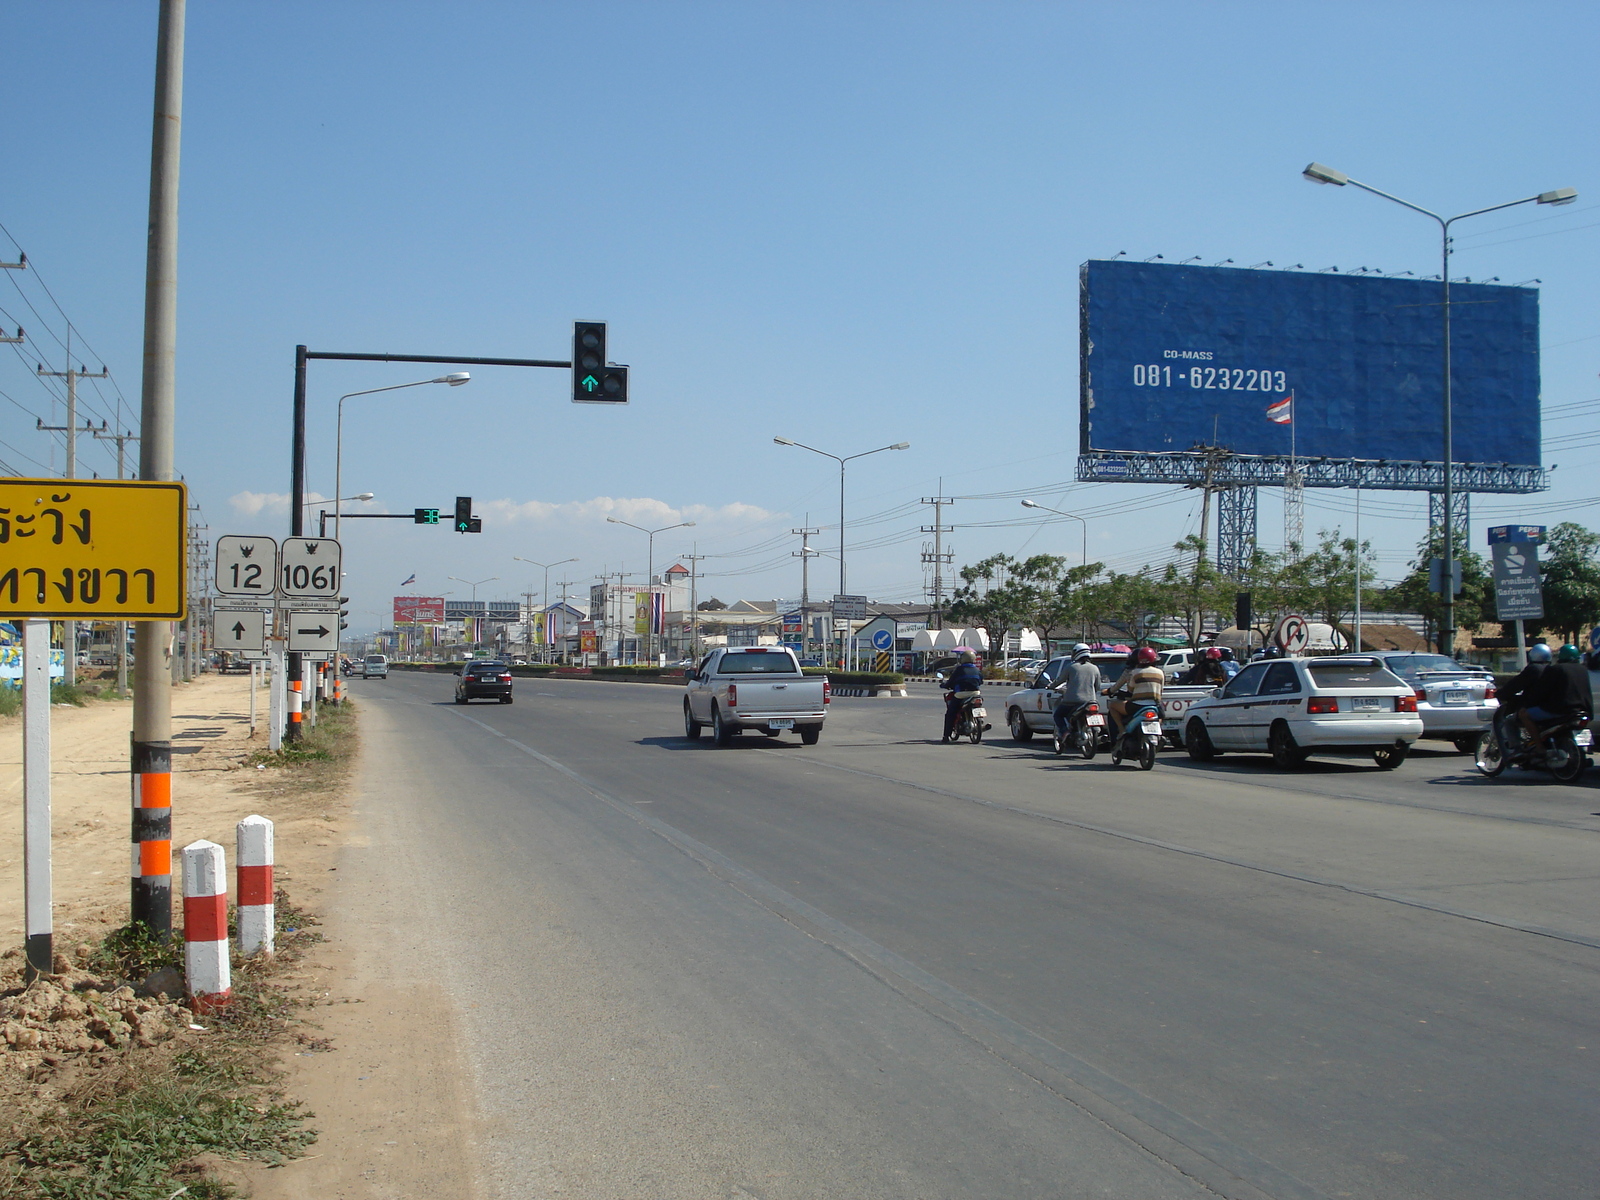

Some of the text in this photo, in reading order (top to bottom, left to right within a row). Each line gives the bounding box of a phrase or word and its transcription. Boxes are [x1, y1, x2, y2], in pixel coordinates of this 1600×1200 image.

[1163, 349, 1213, 361] CO-MASS
[423, 509, 440, 524] 38
[230, 563, 262, 589] 12
[283, 564, 337, 590] 1061
